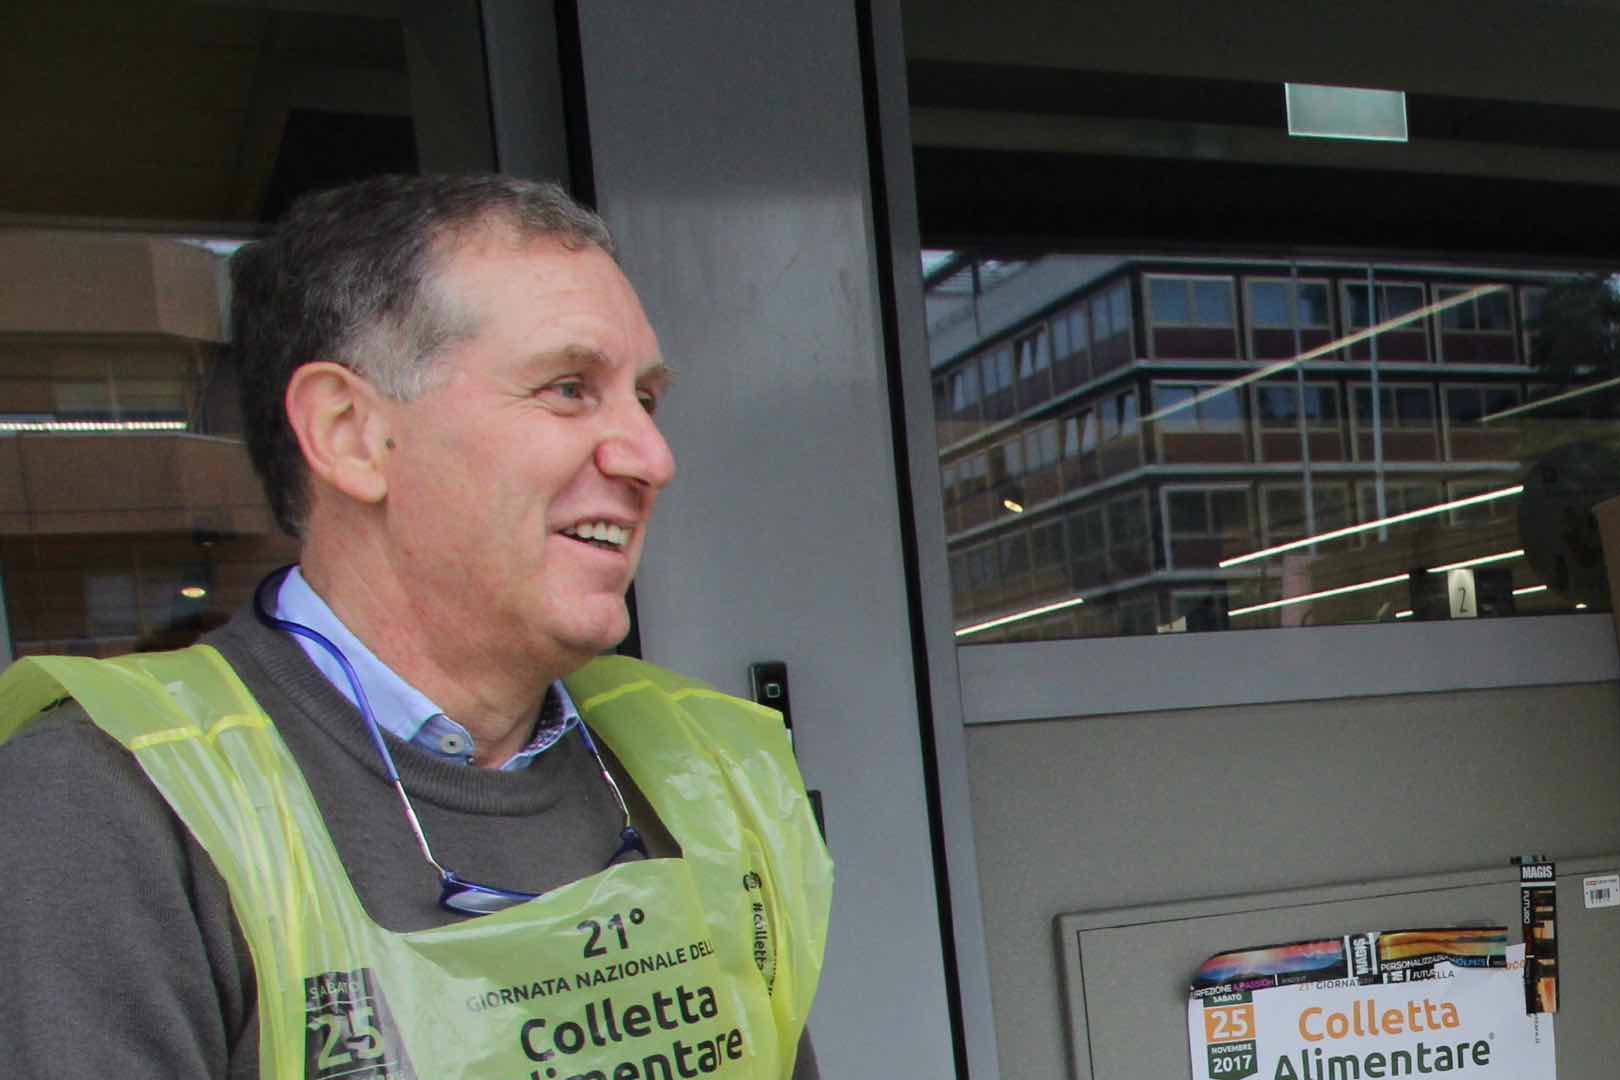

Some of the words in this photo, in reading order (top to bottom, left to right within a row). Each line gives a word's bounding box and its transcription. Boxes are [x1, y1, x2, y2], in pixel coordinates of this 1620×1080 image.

[1522, 865, 1553, 880] MAGIS
[1353, 937, 1369, 976] MAGIS
[309, 981, 360, 1001] SABATO
[465, 979, 571, 1014] GIORNATA
[576, 950, 687, 991] NAZIONALE
[308, 1006, 385, 1071] 25
[520, 984, 720, 1063] Colletta
[1211, 1009, 1250, 1040] 25
[1299, 999, 1462, 1043] Colletta
[1211, 1043, 1253, 1055] NOVEMBRE
[1213, 1055, 1253, 1074] 2017
